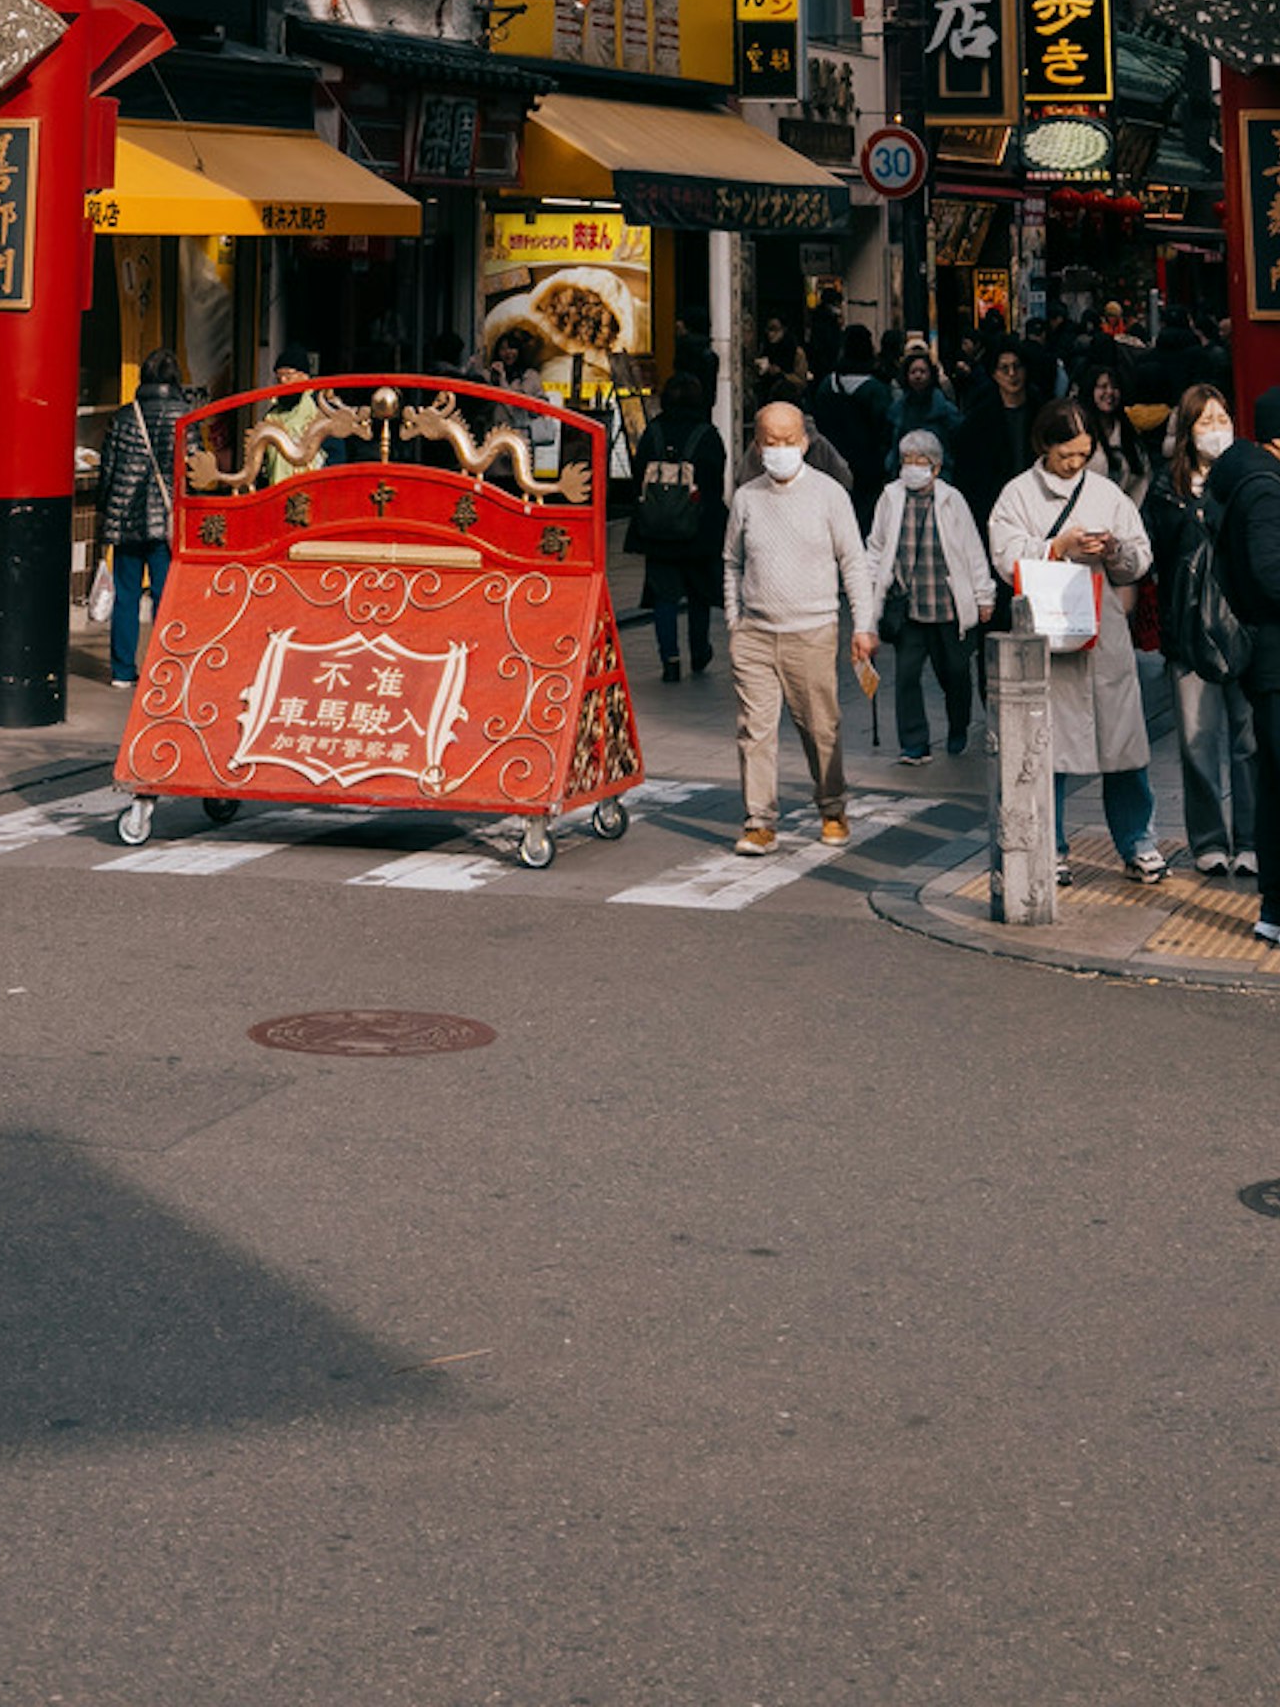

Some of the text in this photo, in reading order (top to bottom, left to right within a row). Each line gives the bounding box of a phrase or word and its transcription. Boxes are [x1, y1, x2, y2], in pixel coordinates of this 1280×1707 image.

[874, 146, 911, 180] 30
[573, 221, 613, 252] 肉まん
